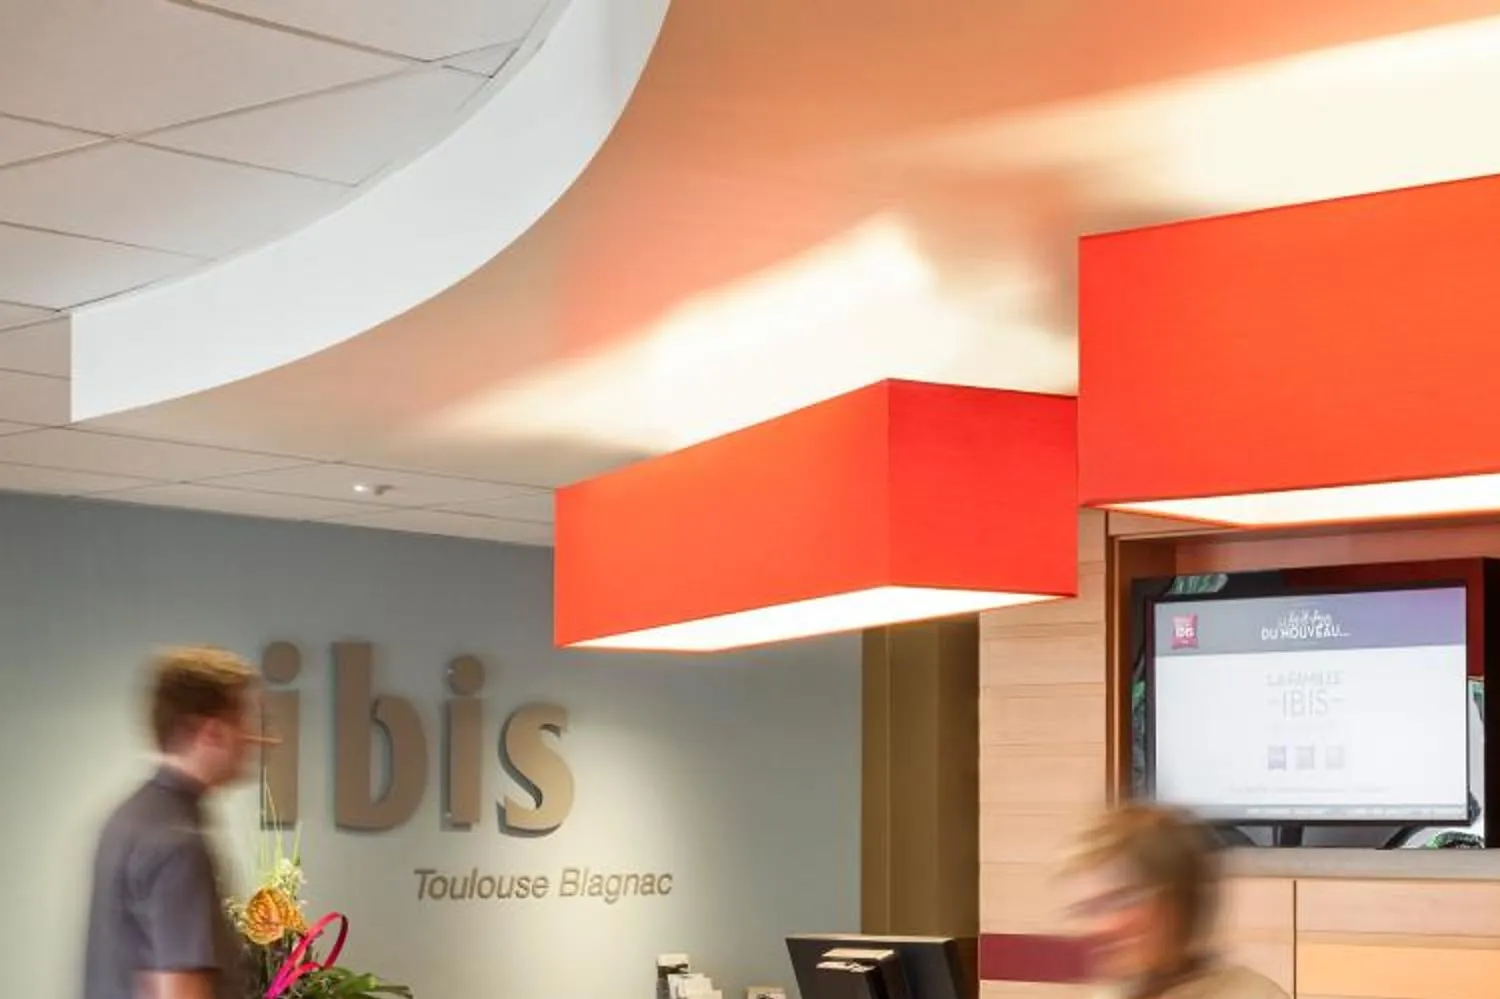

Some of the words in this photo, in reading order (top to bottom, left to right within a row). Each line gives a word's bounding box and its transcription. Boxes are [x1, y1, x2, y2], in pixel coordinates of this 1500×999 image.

[1261, 626, 1279, 641] DU
[1282, 689, 1329, 718] IBIS
[260, 640, 574, 837] ibis
[414, 868, 549, 901] Toulouse
[559, 868, 673, 905] Blagnac
